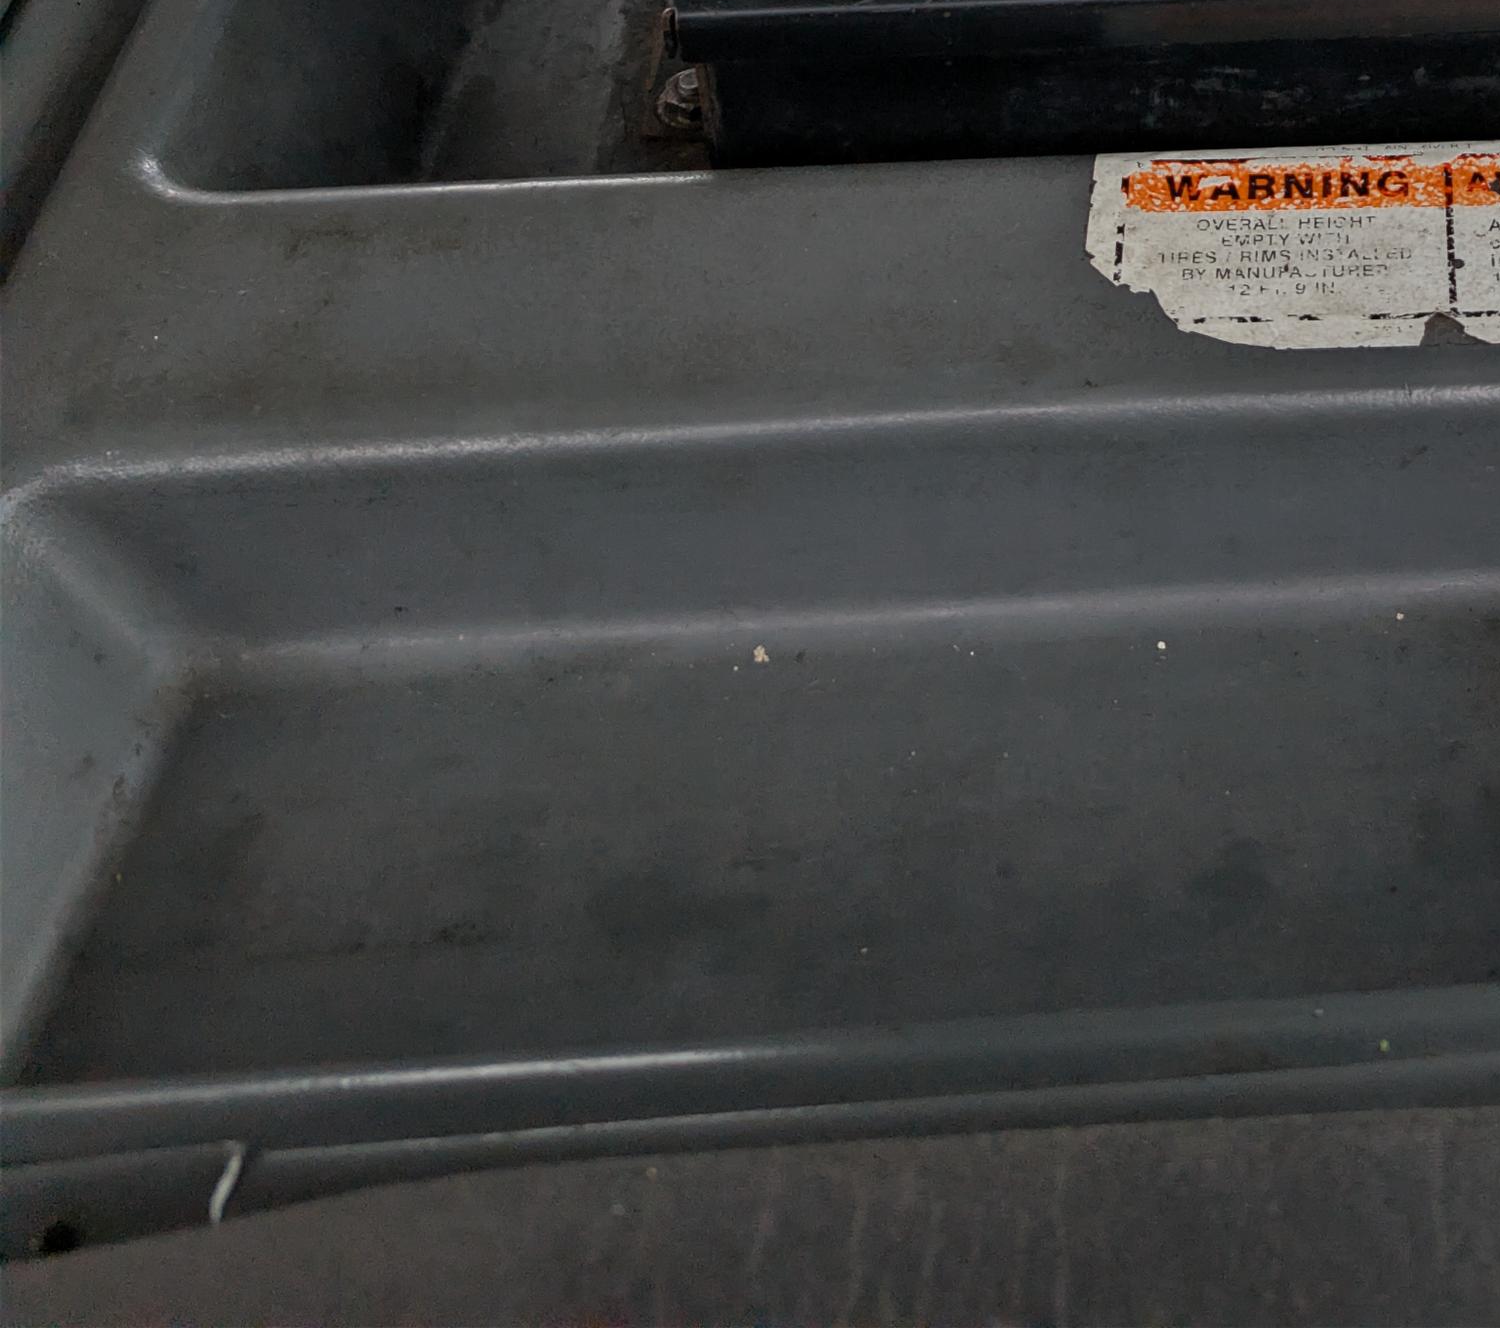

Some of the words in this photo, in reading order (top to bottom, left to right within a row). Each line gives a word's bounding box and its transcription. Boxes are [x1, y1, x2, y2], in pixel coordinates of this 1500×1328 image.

[1166, 170, 1409, 201] WARNING
[1221, 233, 1290, 246] EMPTY
[1158, 250, 1217, 264] TIRES
[1240, 250, 1291, 262] RIMS
[1300, 247, 1412, 261] INSALLED
[1182, 267, 1206, 280] BY
[1295, 282, 1306, 295] 9
